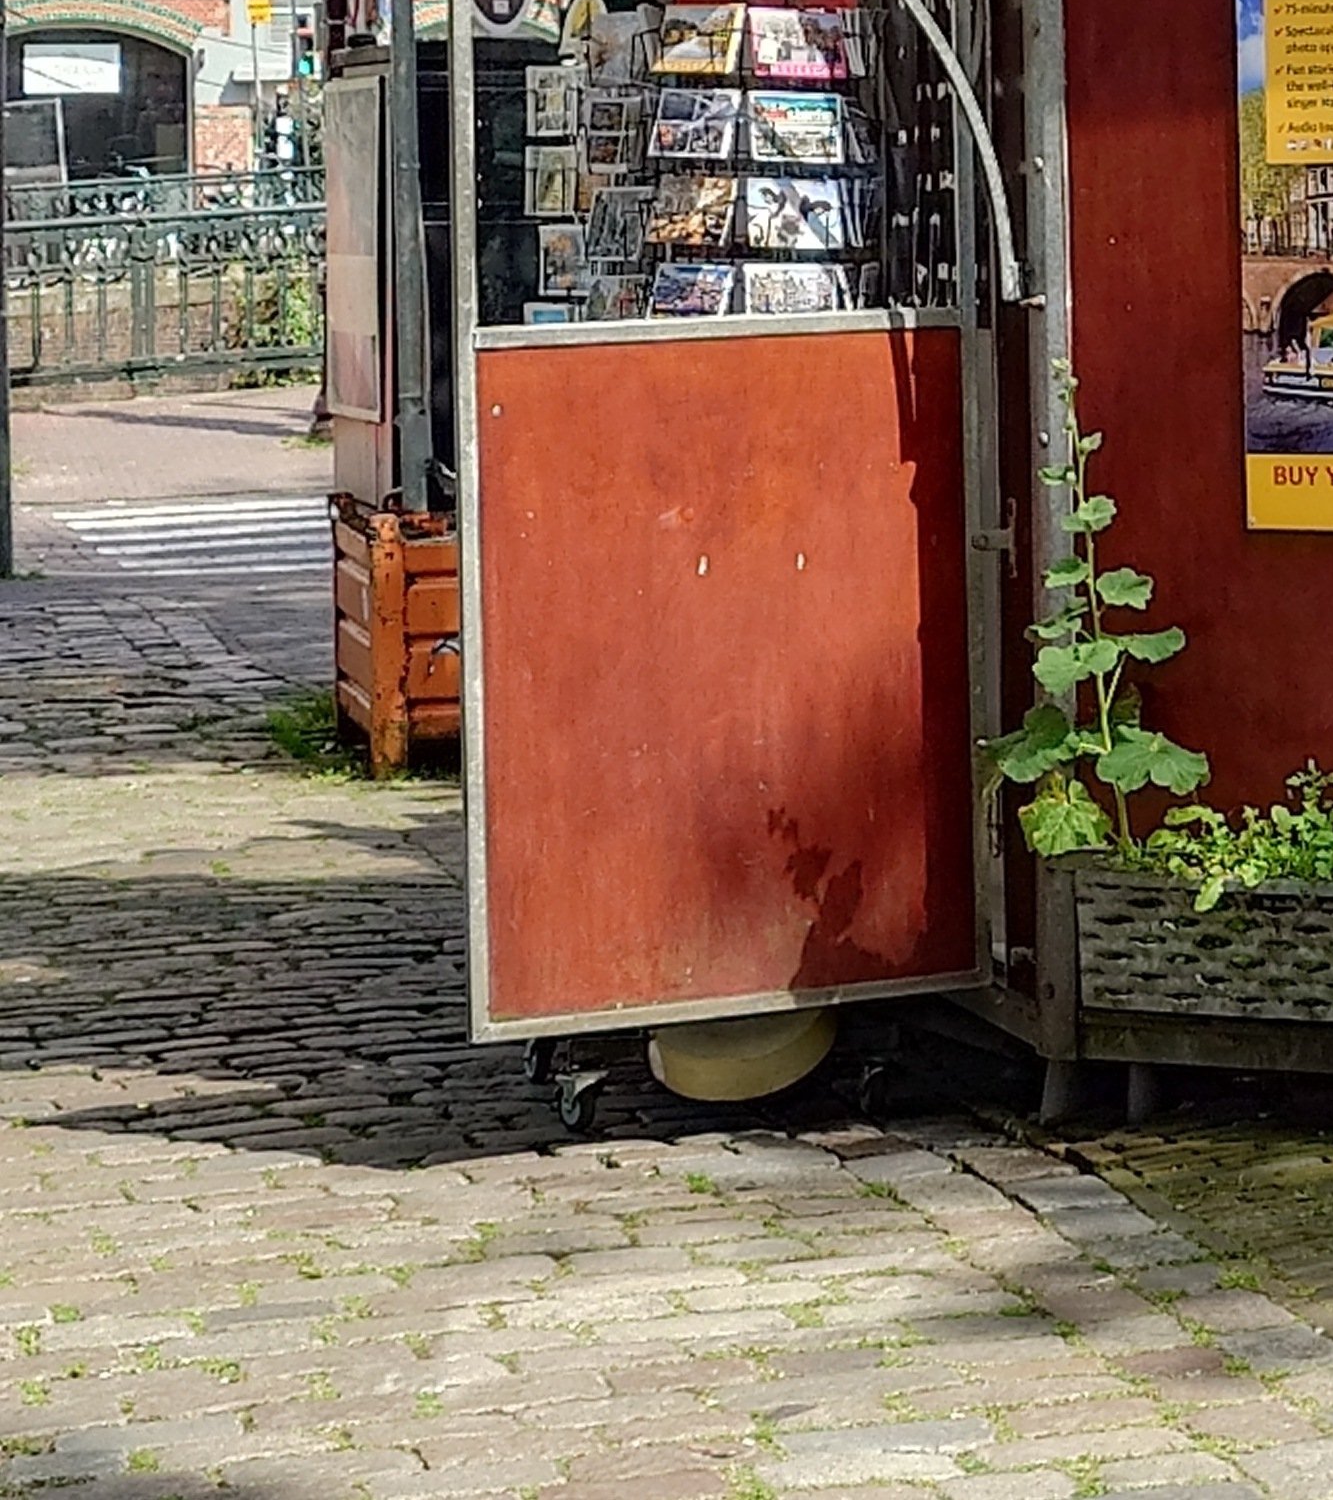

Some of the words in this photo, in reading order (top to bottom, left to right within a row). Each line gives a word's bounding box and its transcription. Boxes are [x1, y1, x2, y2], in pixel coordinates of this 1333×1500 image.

[1285, 41, 1317, 54] photo
[1286, 64, 1305, 75] Fun
[1286, 81, 1304, 92] the
[1273, 466, 1319, 487] BUY
